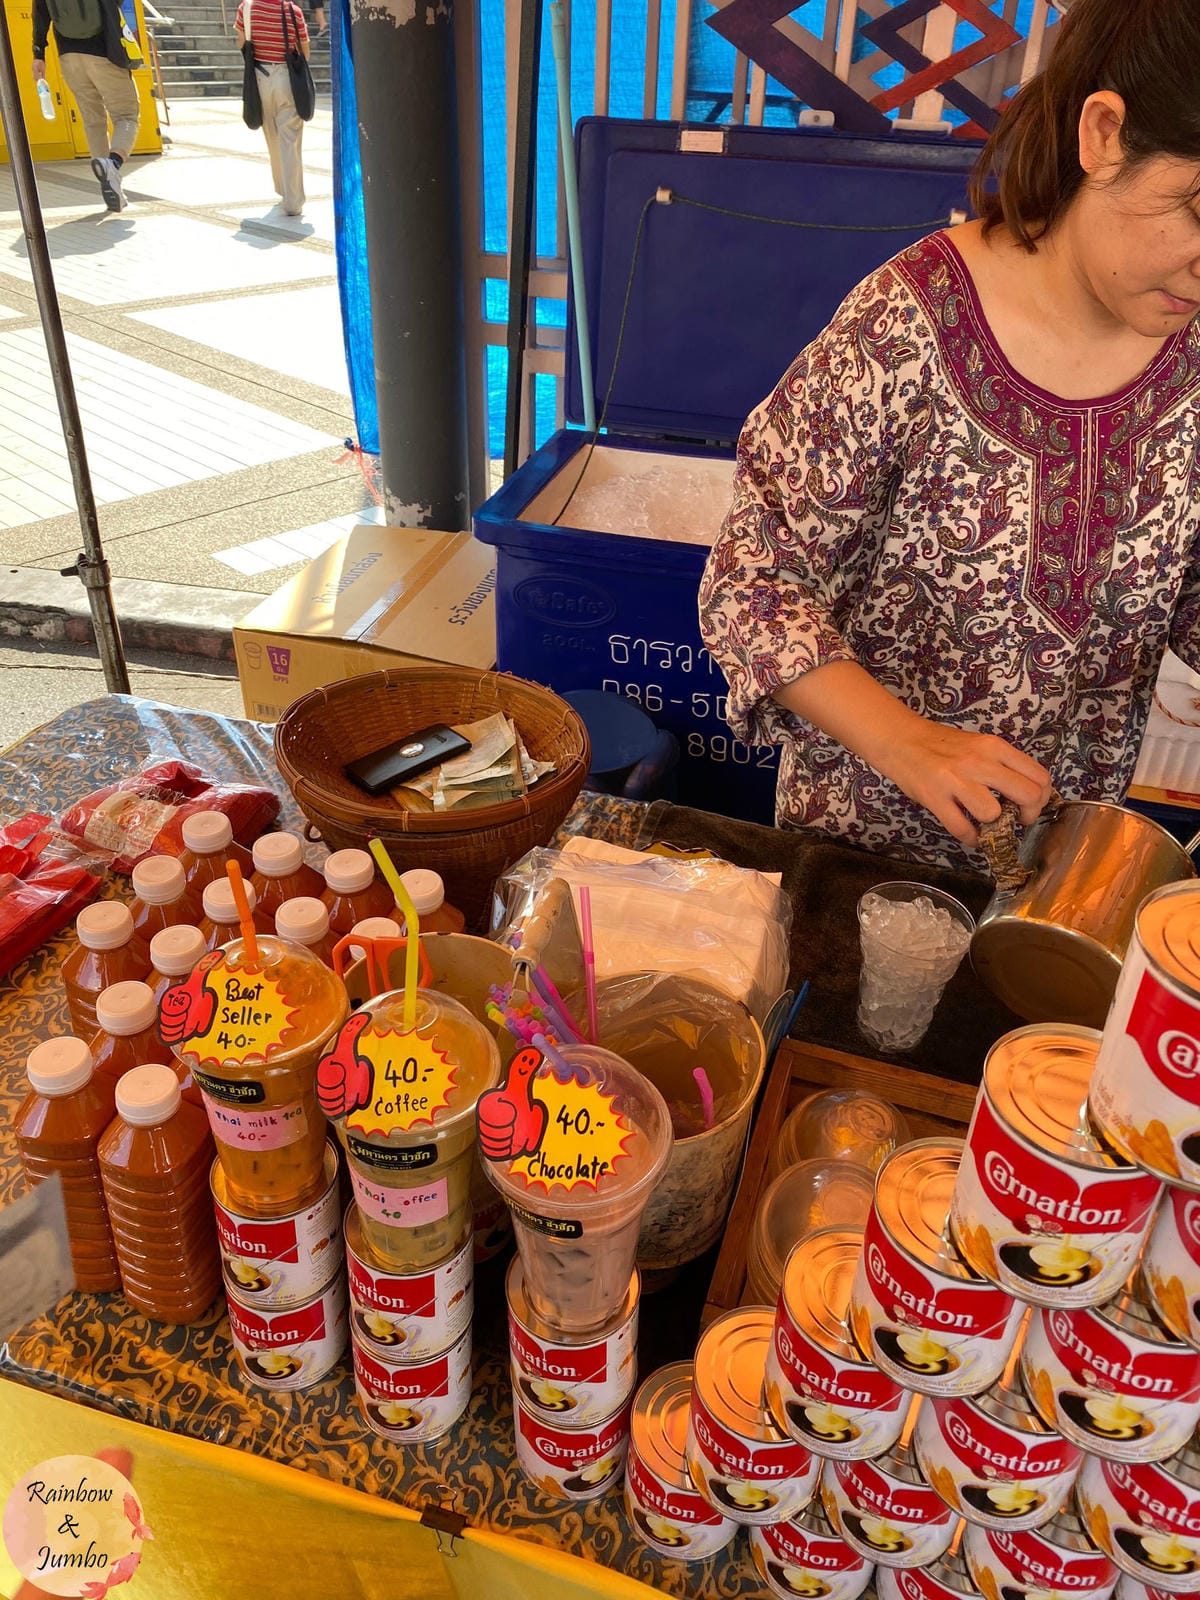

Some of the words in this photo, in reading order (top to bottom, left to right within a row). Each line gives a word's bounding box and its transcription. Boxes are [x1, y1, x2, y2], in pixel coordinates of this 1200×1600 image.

[271, 652, 288, 666] 16
[687, 732, 776, 769] 8902
[225, 978, 265, 1002] Best
[221, 1007, 273, 1026] Seller
[215, 1110, 242, 1127] Thai
[248, 1116, 278, 1129] milk
